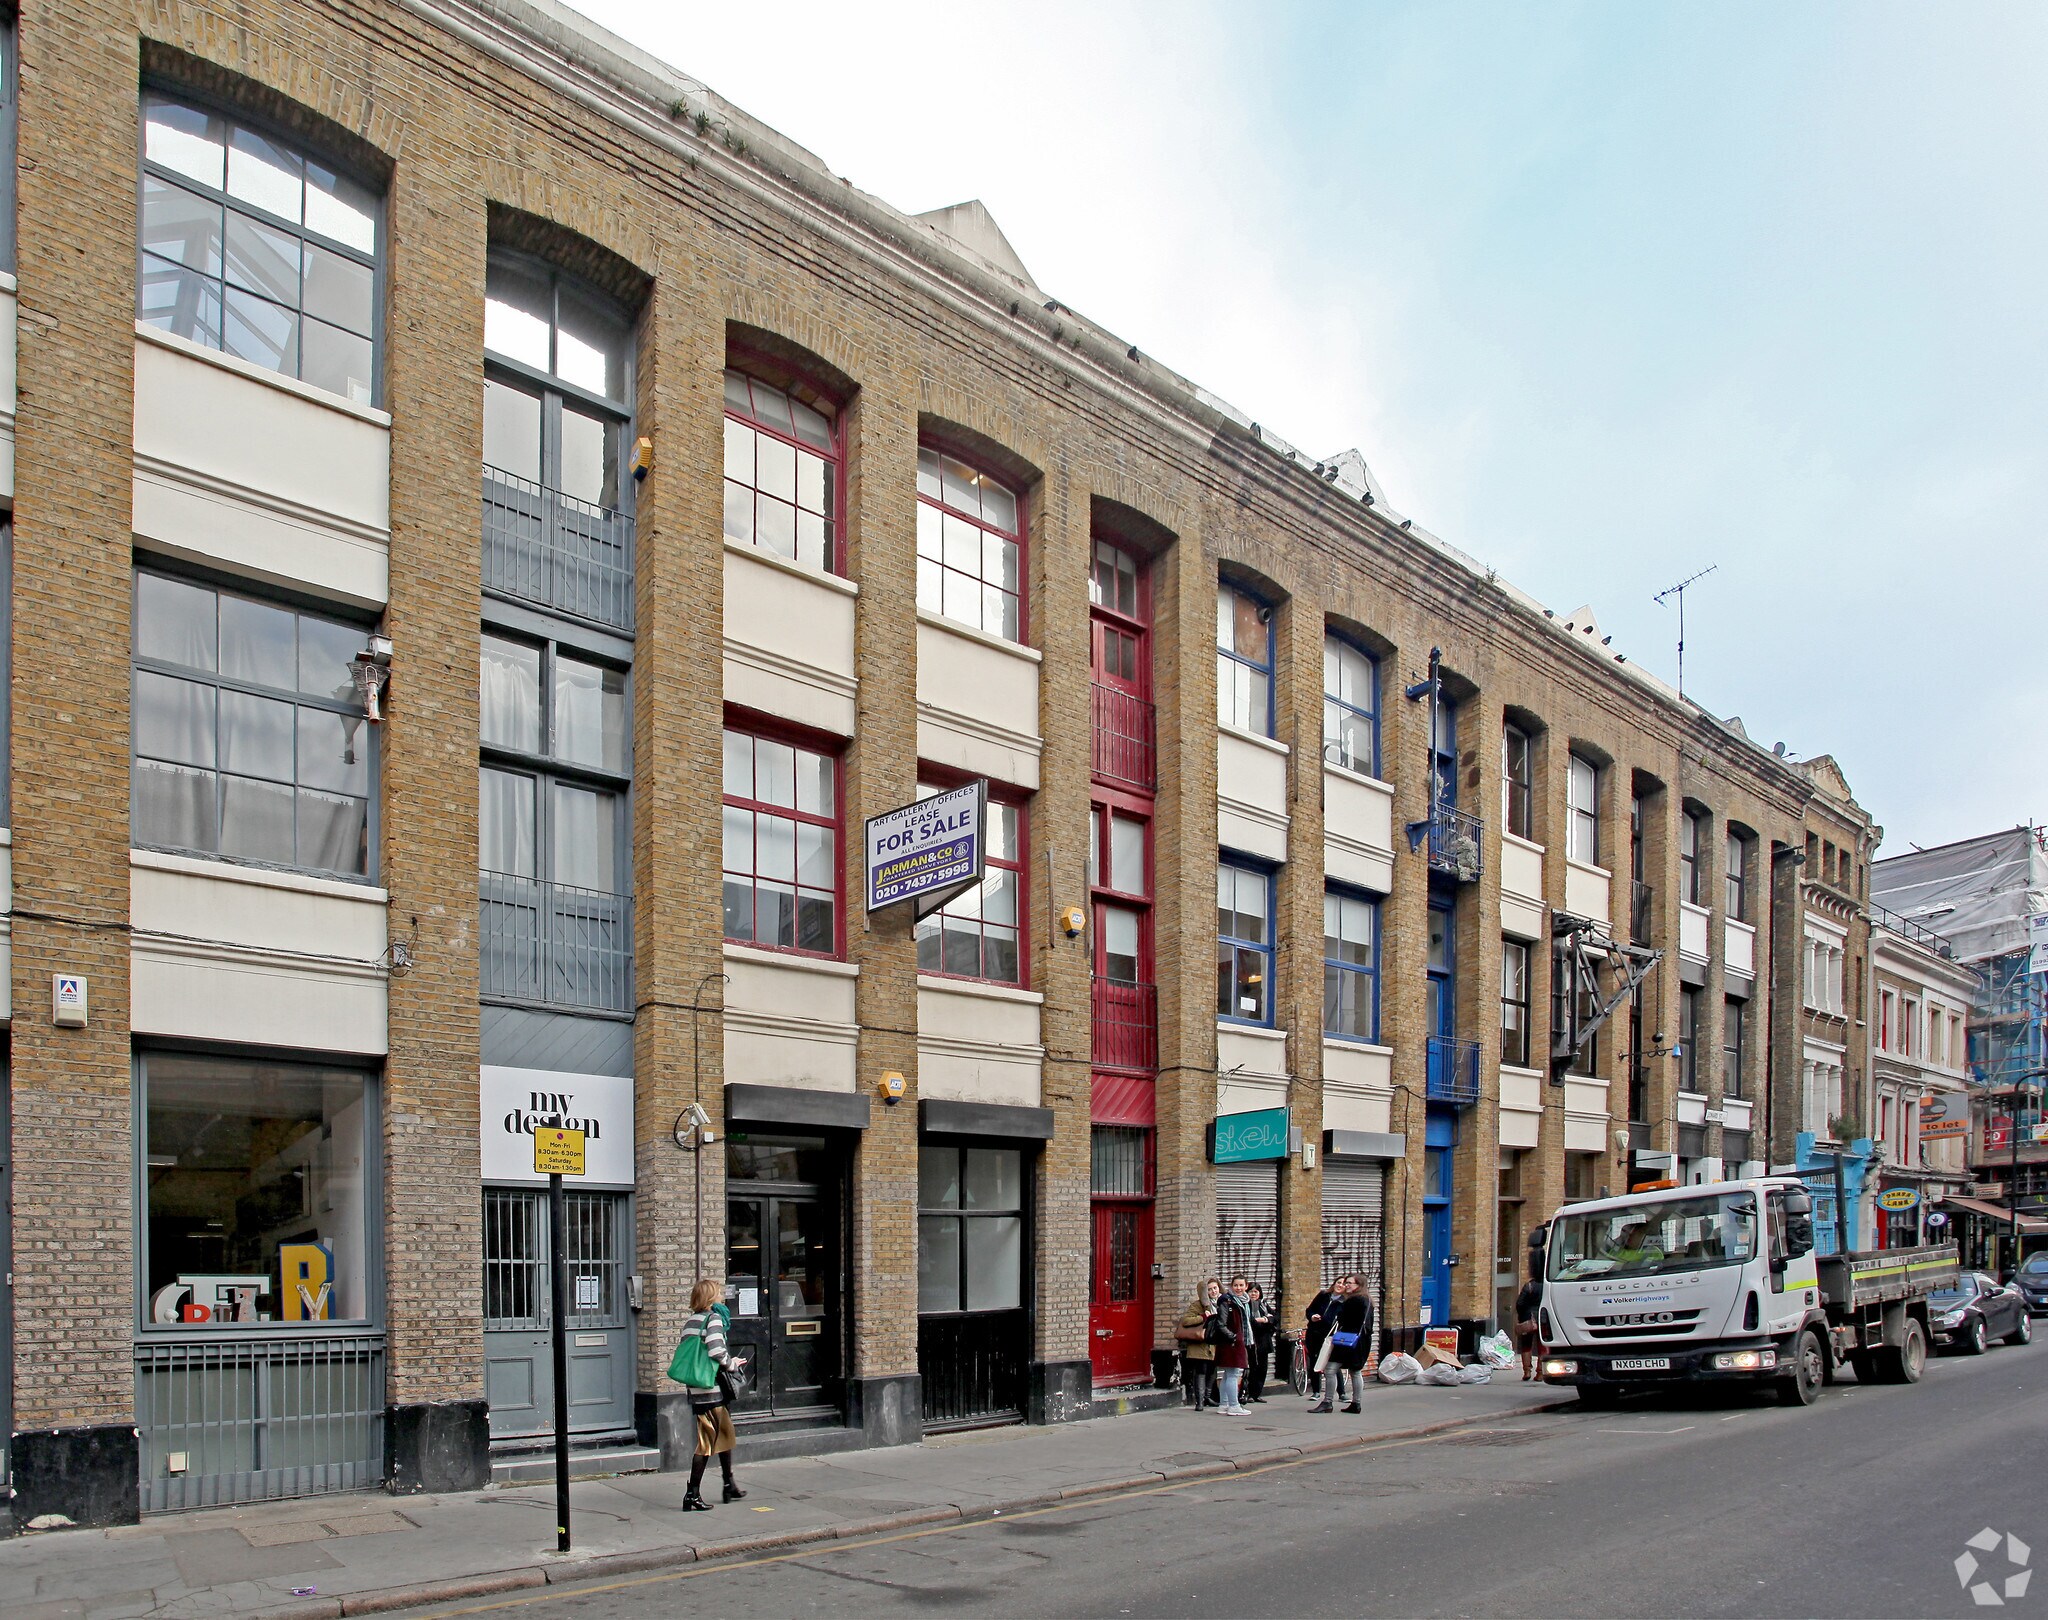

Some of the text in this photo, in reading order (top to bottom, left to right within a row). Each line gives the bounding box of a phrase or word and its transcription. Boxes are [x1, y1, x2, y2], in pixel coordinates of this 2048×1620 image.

[873, 816, 889, 828] ART
[891, 803, 929, 821] GALLERY
[938, 786, 975, 805] OFFICES
[904, 809, 940, 828] LEASE
[876, 809, 971, 855] FOR SALE
[912, 838, 943, 851] ENQUIRIES
[883, 857, 952, 883] CHARTERED SURVEYORS
[530, 1091, 574, 1117] my
[548, 1157, 572, 1165] Saturday
[1580, 1277, 1700, 1292] EUROCARGO
[1604, 1311, 1674, 1327] IVECO
[1615, 1360, 1643, 1369] NX09
